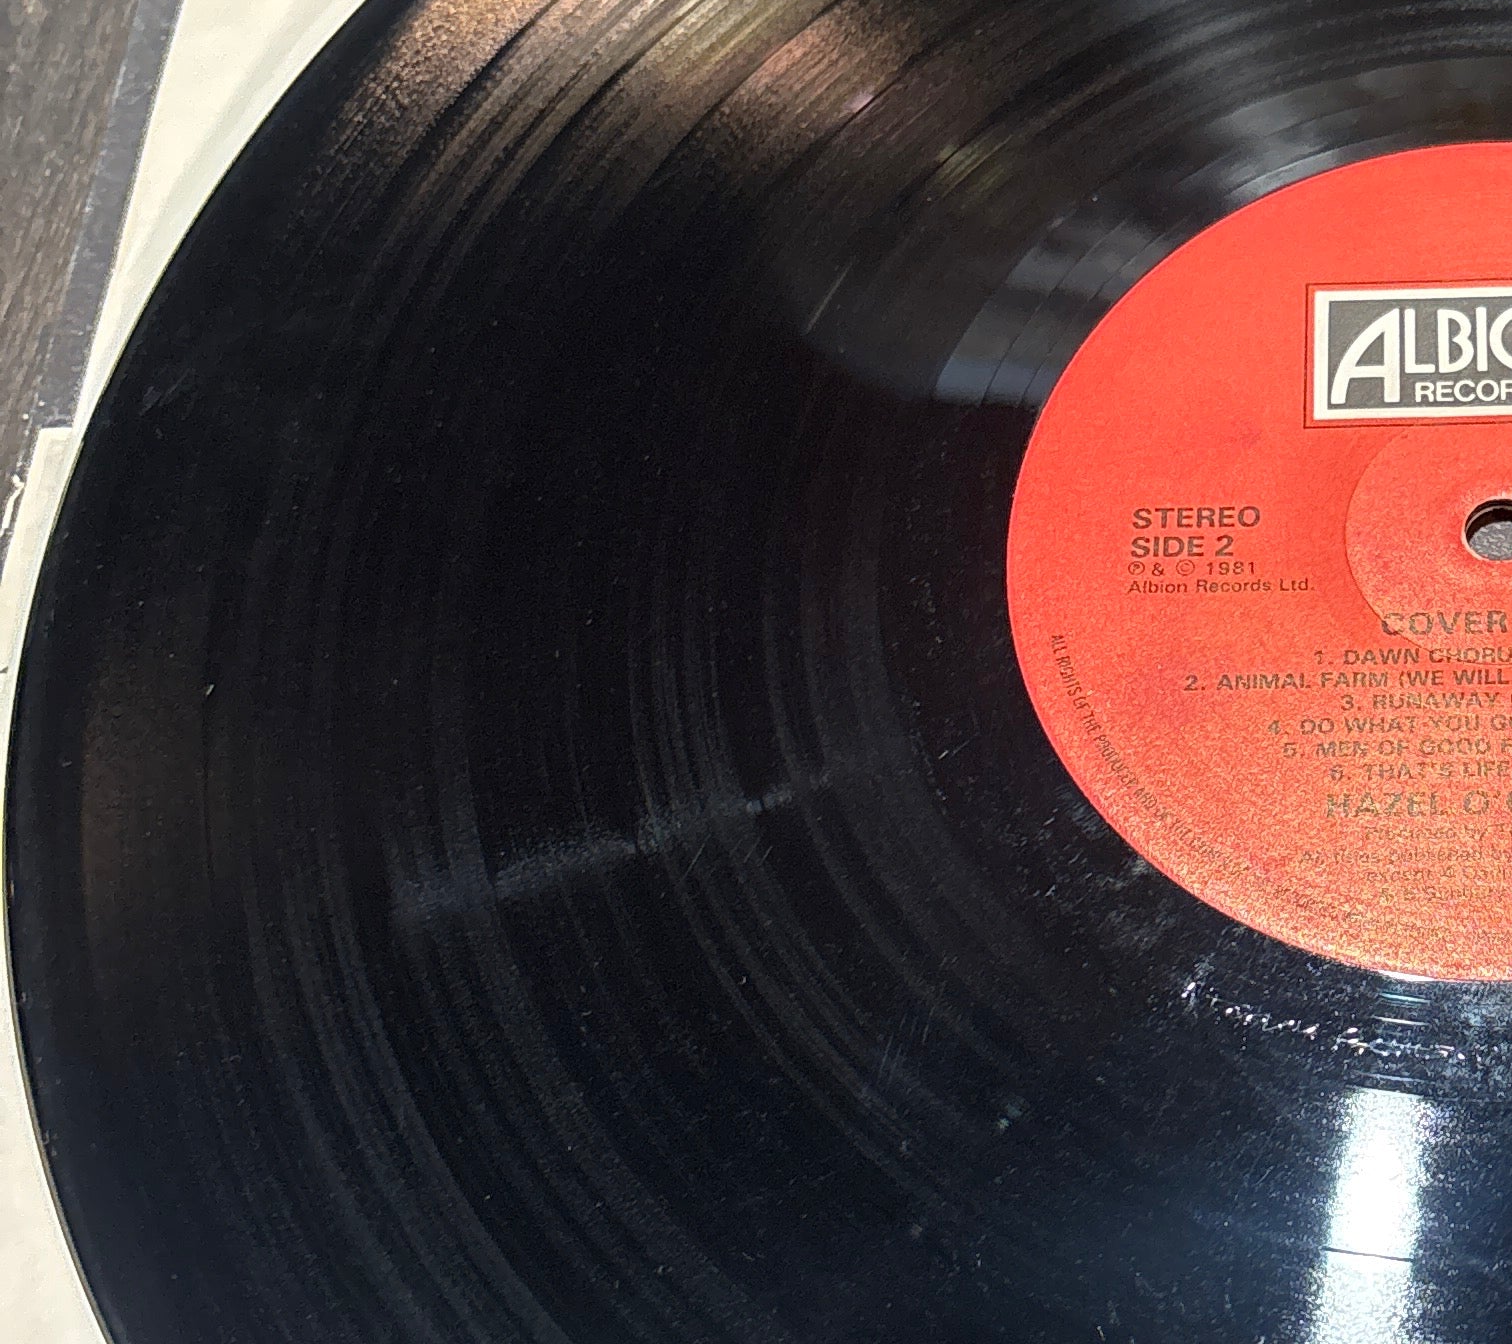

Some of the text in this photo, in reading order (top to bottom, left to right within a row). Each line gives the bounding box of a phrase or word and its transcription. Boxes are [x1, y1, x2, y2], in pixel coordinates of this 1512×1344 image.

[1132, 506, 1261, 529] STEREO
[1130, 534, 1235, 557] SIDE 2
[1206, 561, 1256, 576] 1981
[1127, 578, 1315, 594] Albion Records Ltd.
[1381, 609, 1509, 636] COVER
[1342, 648, 1420, 665] DAWN
[1184, 674, 1206, 691] 2.
[1216, 673, 1312, 691] ANIMAL
[1320, 671, 1388, 689] FARM
[1398, 669, 1445, 688] (WE
[1453, 668, 1510, 687] WILL
[1340, 694, 1361, 712] 3.
[1372, 691, 1505, 710] RUNAWAY
[1266, 720, 1290, 735] 4.
[1300, 718, 1335, 735] DO
[1344, 716, 1417, 734] WHAT
[1429, 715, 1481, 731] YOU
[1315, 740, 1370, 758] MEN
[1377, 739, 1410, 757] OF
[1418, 737, 1492, 755] GOOD
[1363, 762, 1451, 780] THAT'S
[1462, 760, 1511, 778] LIFE
[1326, 790, 1446, 819] HAZEL
